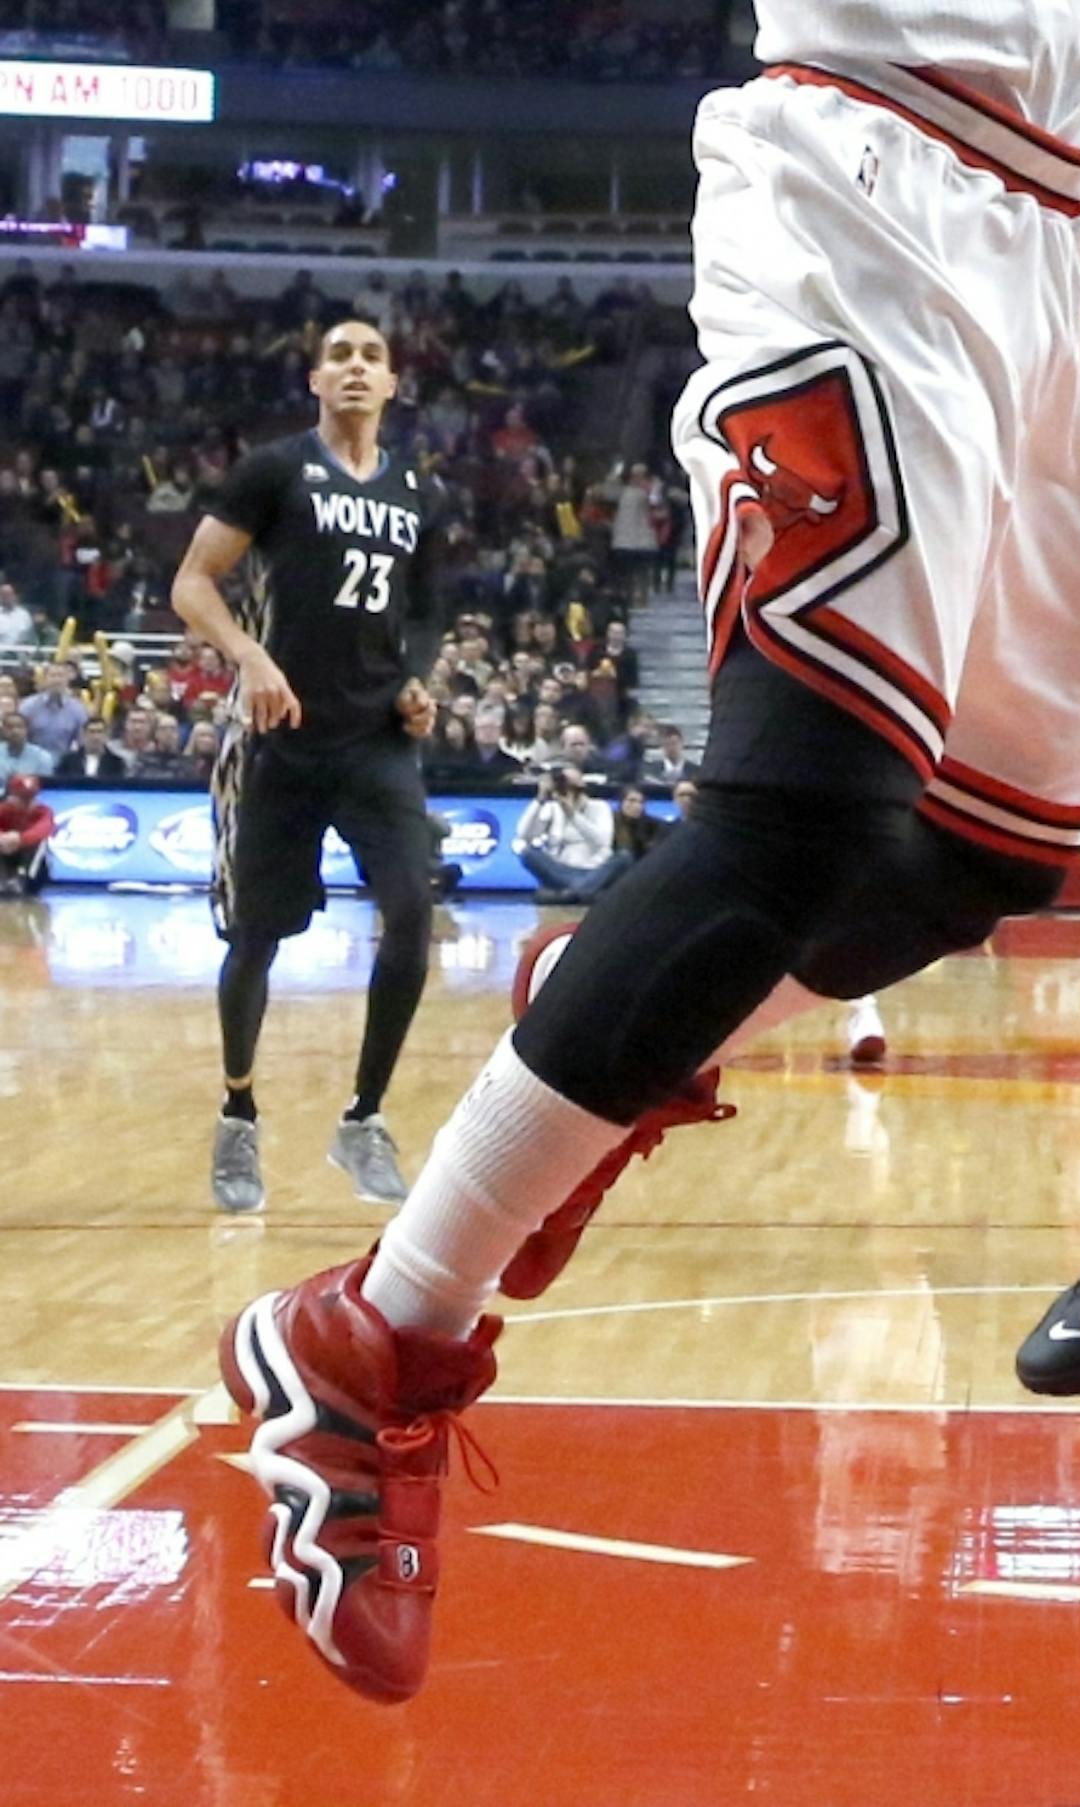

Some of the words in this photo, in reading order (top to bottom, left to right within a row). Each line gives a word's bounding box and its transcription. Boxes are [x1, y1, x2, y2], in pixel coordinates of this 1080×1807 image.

[52, 74, 99, 104] AM
[121, 76, 198, 110] 1000
[311, 492, 419, 554] WOLVES
[333, 548, 394, 613] 23
